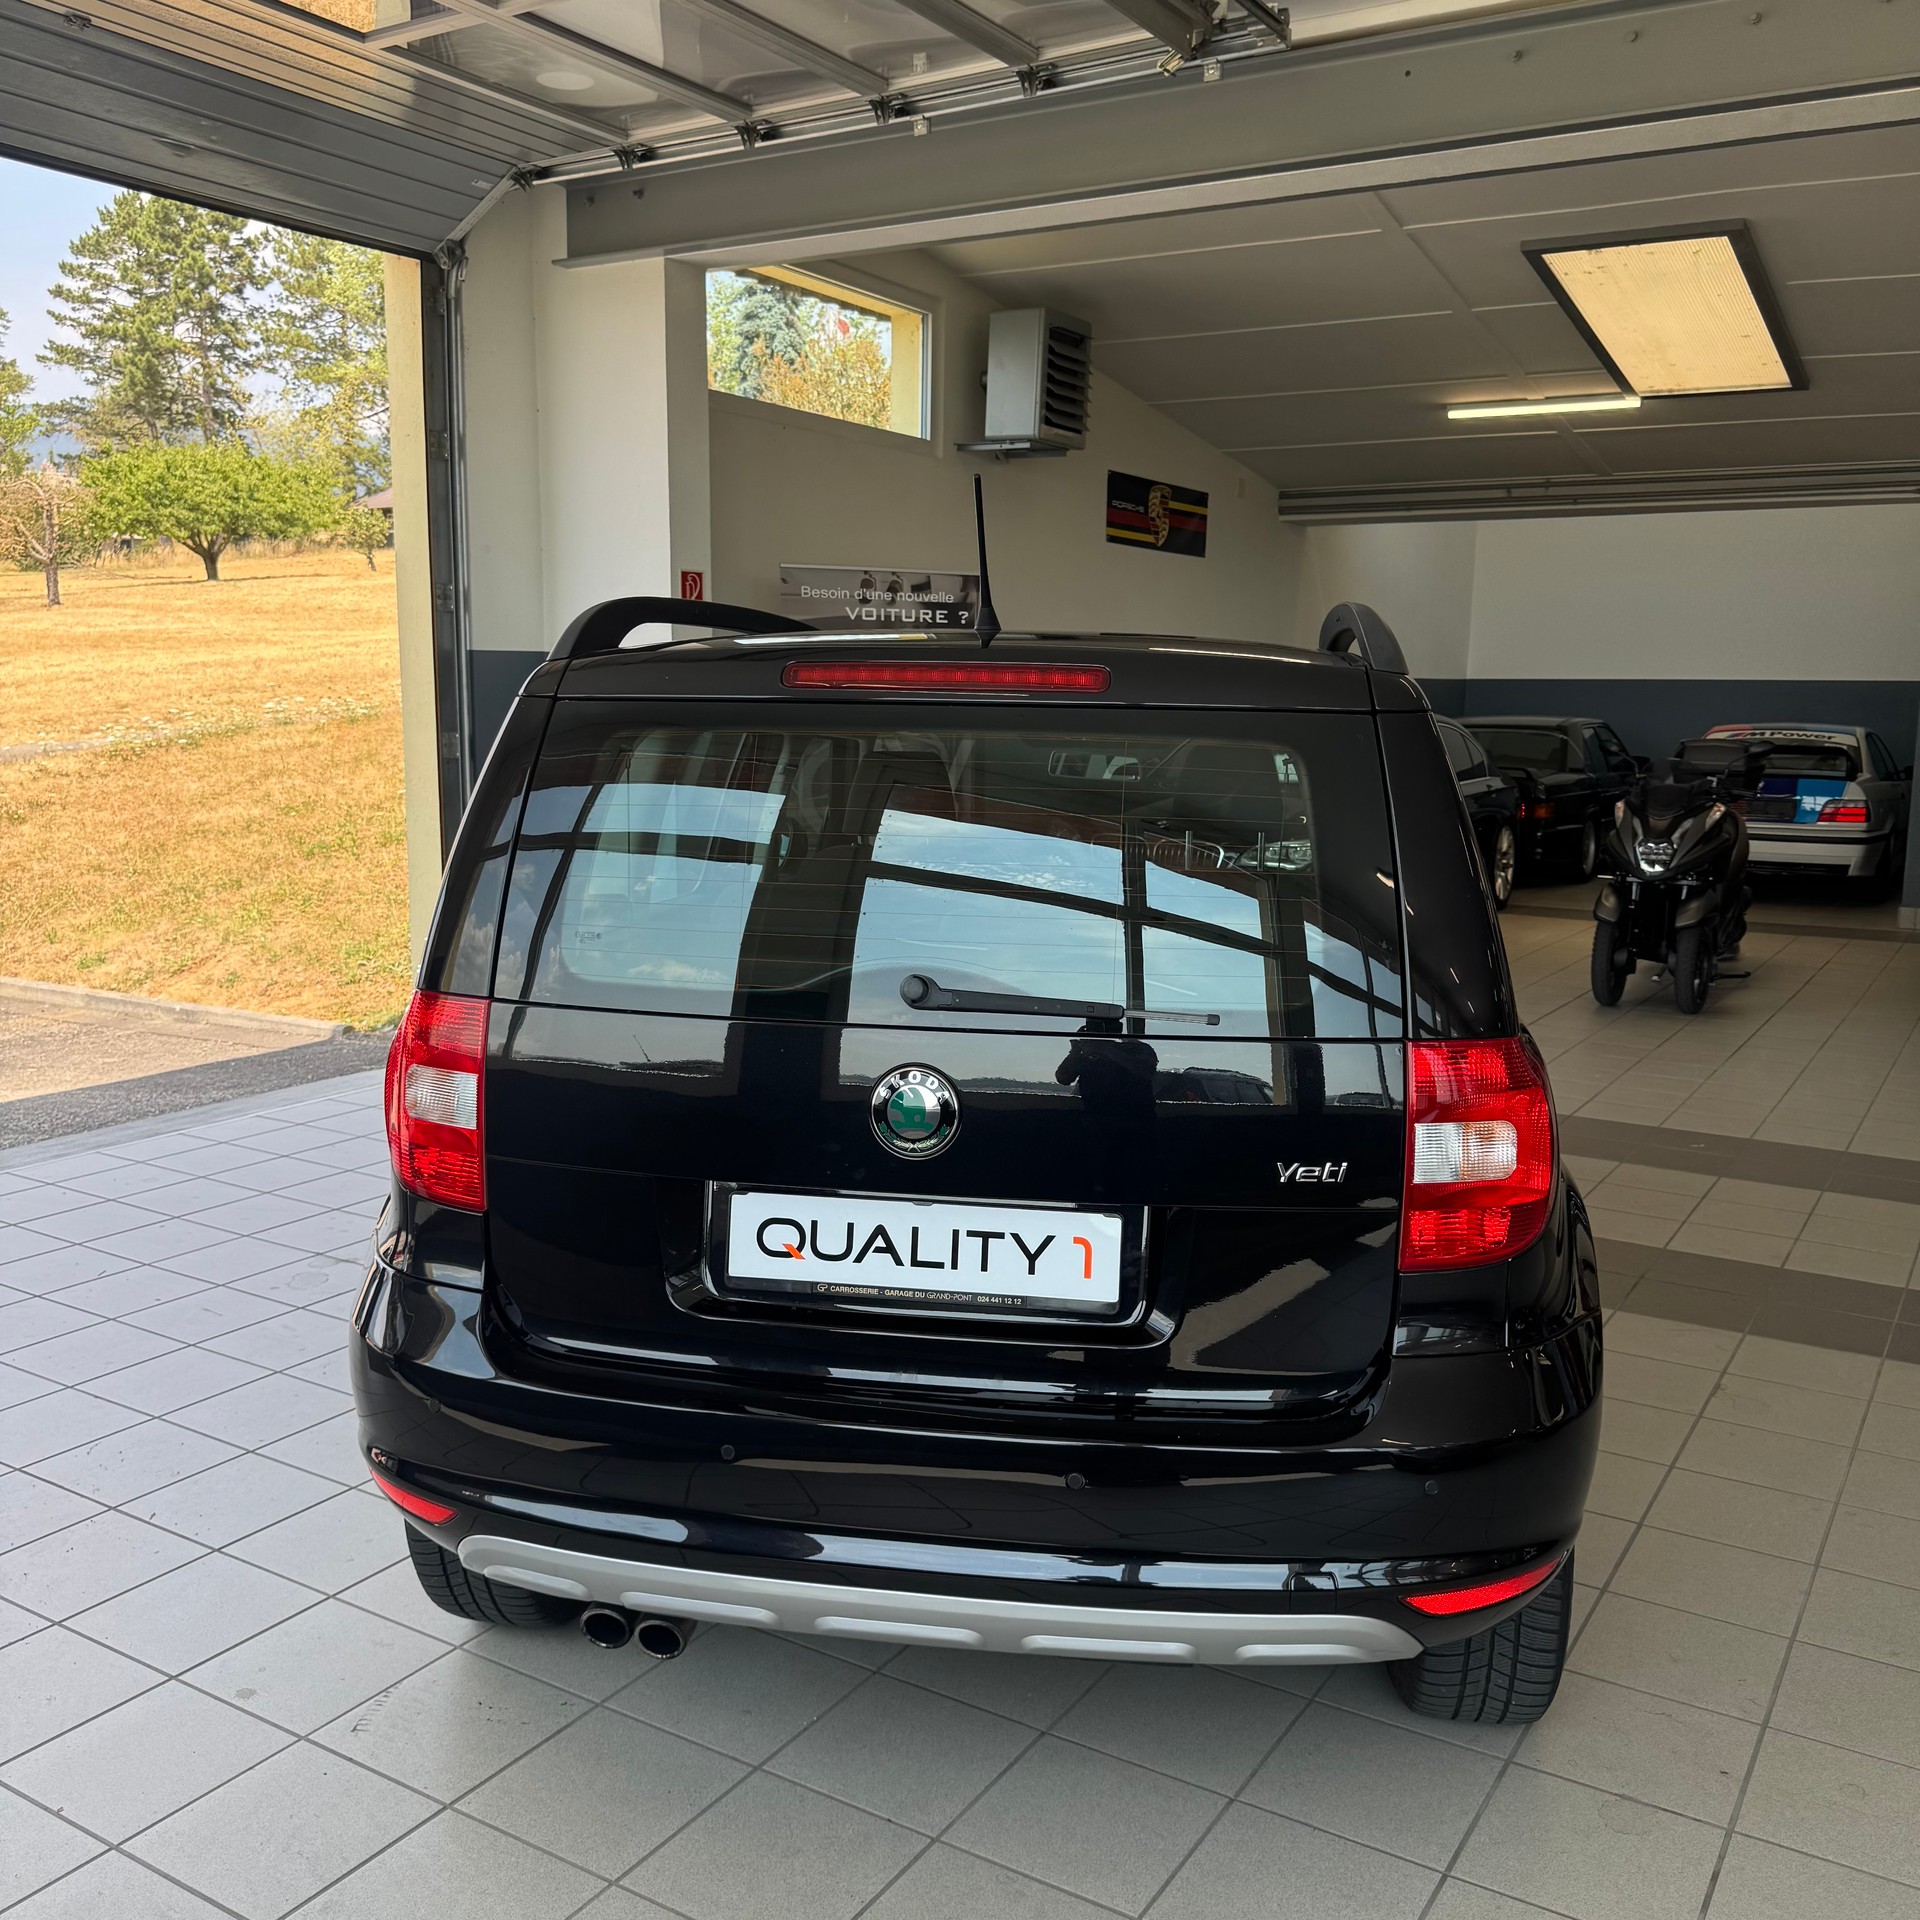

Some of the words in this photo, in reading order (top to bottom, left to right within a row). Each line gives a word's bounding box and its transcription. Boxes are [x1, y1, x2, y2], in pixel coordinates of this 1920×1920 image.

[801, 586, 849, 599] Besoin
[854, 588, 893, 601] d'une
[897, 591, 954, 603] nouvelle
[845, 607, 948, 623] VOITURE
[958, 611, 969, 624] ?
[1769, 731, 1837, 740] Power
[1277, 1162, 1348, 1183] Yeti
[756, 1217, 1056, 1276] QUALITY
[1072, 1236, 1093, 1279] 1
[830, 1285, 879, 1295] CARROSSERIE
[884, 1289, 914, 1297] GARAGE
[926, 1291, 973, 1301] GRAND-PONT
[977, 1295, 989, 1303] 024
